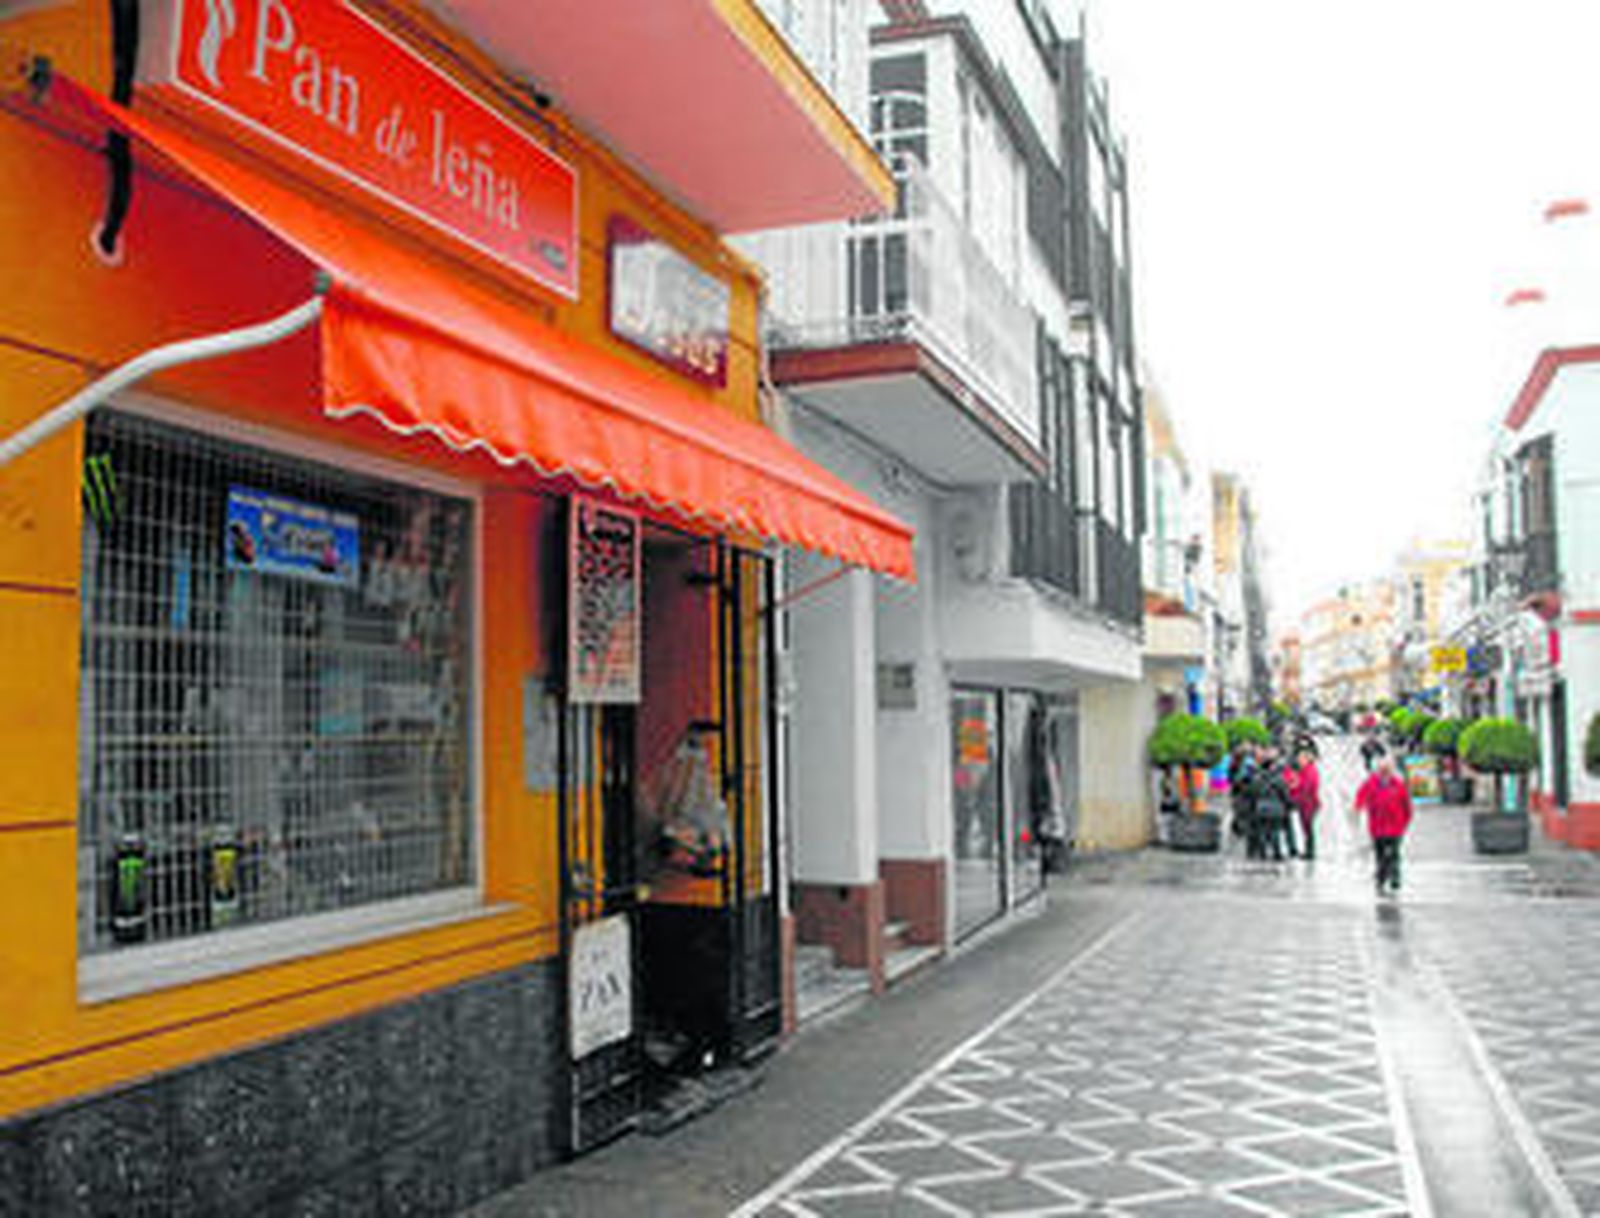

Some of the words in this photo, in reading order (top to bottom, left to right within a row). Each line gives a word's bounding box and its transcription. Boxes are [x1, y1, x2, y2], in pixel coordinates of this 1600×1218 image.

[245, 0, 359, 136] Pan
[374, 106, 418, 165] de
[430, 111, 521, 231] leña
